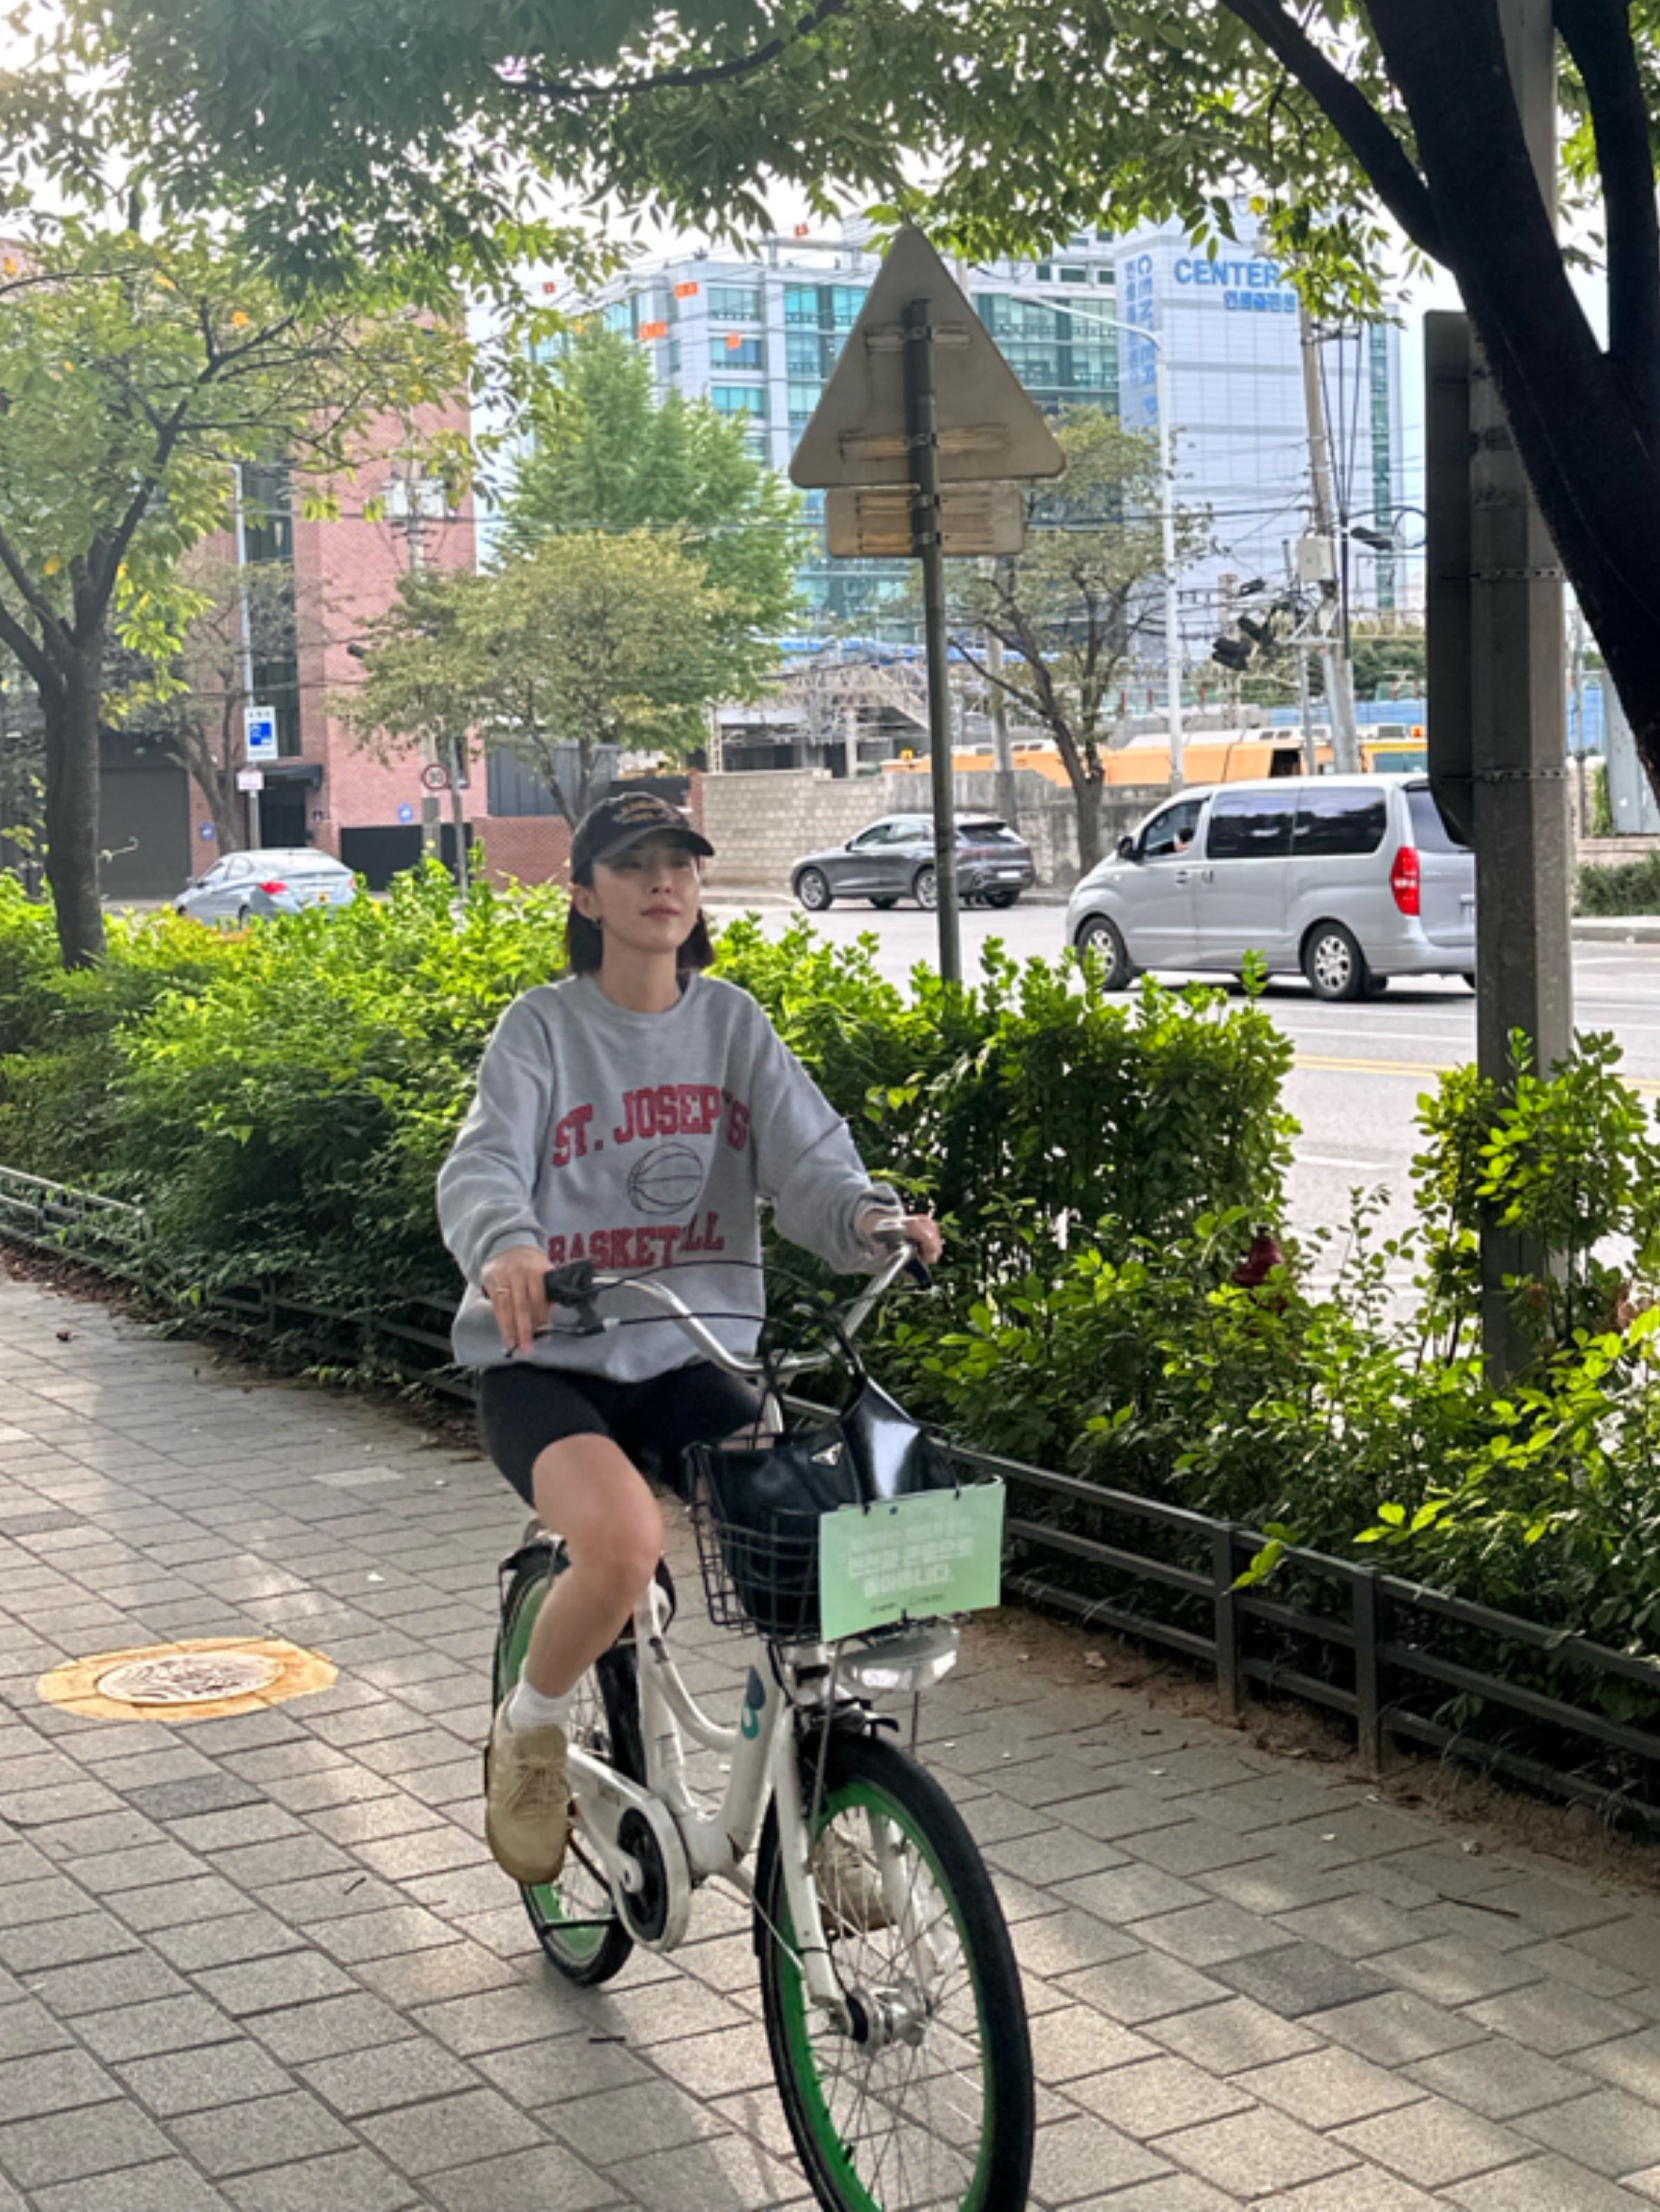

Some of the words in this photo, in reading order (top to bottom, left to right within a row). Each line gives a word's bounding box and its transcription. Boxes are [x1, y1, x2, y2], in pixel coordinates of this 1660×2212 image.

[1174, 258, 1281, 288] CENTER
[553, 1104, 604, 1168] ST.
[614, 1083, 751, 1150] JOSEP'S
[548, 1211, 725, 1269] BASKETLL
